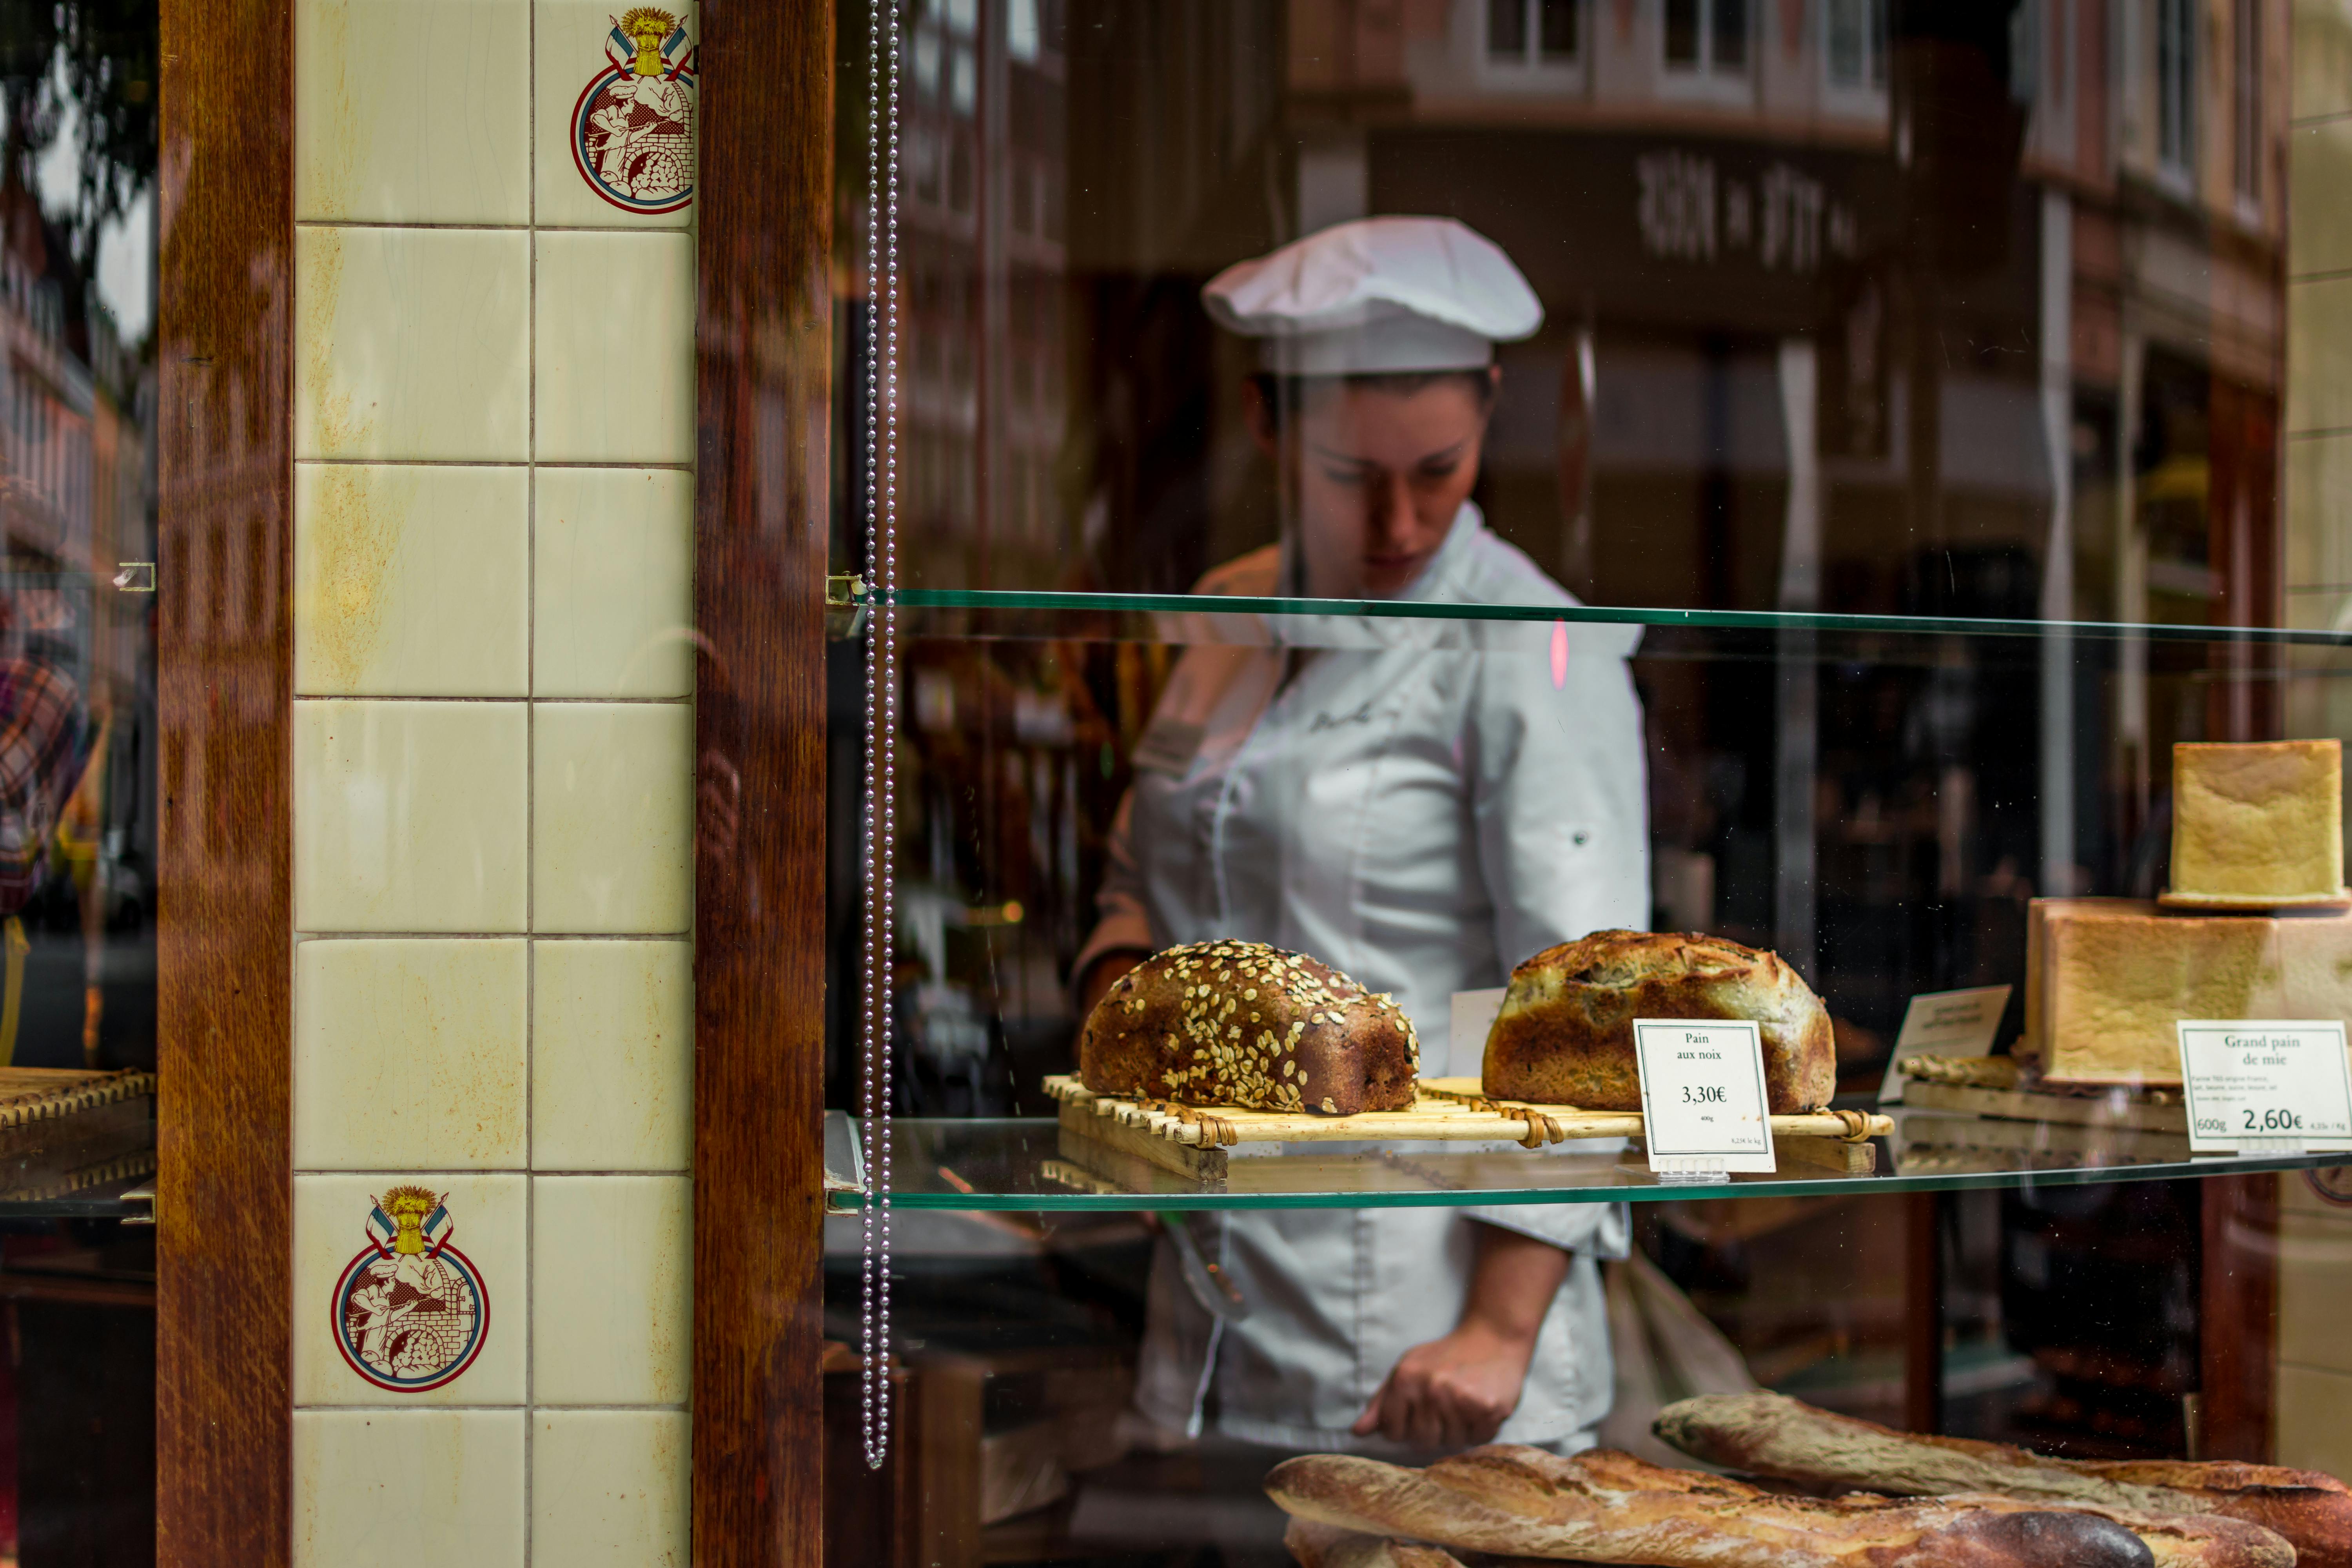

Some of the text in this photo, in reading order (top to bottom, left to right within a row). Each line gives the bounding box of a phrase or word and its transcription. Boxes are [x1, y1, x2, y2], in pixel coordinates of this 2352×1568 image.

[1686, 1033, 1709, 1044] Pain
[2225, 1035, 2300, 1051] Grand pain
[1699, 1049, 1722, 1060] noix
[2243, 1053, 2287, 1065] de mie
[1682, 1086, 1727, 1105] 3,30€
[2197, 1118, 2227, 1132] 600g
[2243, 1109, 2303, 1132] 2,60€
